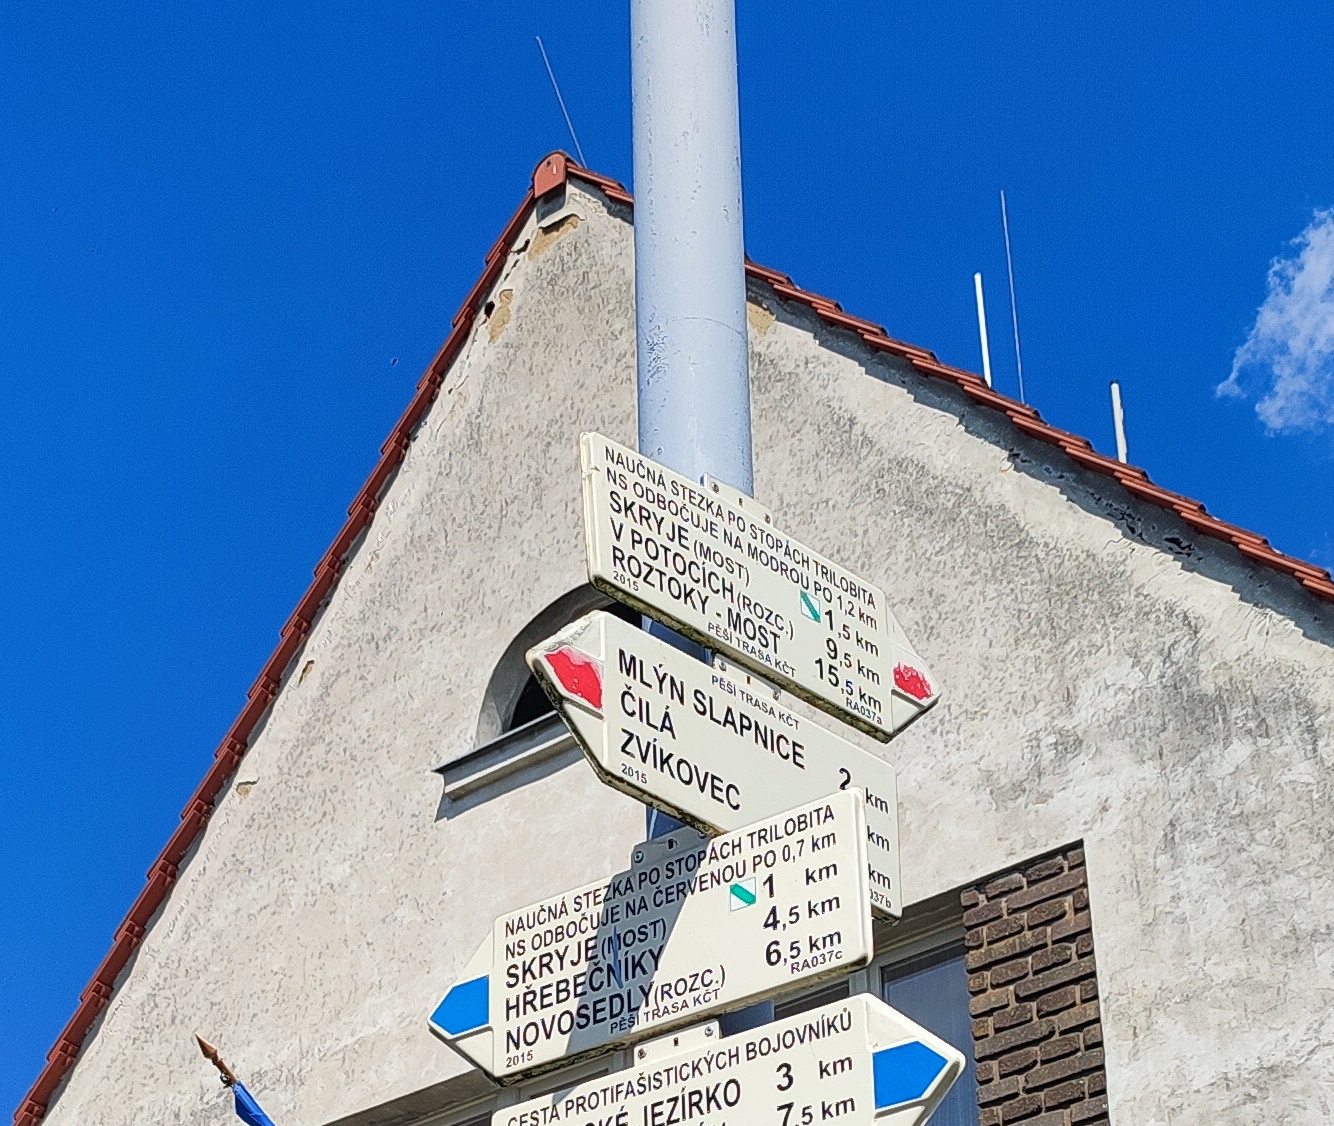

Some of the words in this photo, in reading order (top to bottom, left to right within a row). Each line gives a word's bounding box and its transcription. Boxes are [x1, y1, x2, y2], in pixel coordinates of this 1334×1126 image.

[605, 446, 667, 498] NAUČNÁ
[671, 480, 724, 522] STEZKA
[728, 510, 745, 532] PO
[750, 524, 809, 571] STOPÁCH
[813, 560, 876, 609] TRILOBITA
[607, 467, 627, 490] NS
[633, 482, 718, 539] ODBOČUJE
[724, 530, 743, 553] NA
[748, 542, 809, 595] MODROU
[814, 581, 832, 603] PO
[837, 595, 855, 617] 1,2
[859, 610, 877, 630] km
[610, 490, 690, 551] SKRYJE
[694, 540, 749, 586] (MOST)
[825, 611, 850, 640] 1,5
[856, 631, 878, 657] km
[611, 571, 639, 591] 2015
[610, 517, 623, 542] V
[631, 528, 734, 604] POTOCÍCH
[736, 592, 793, 640] (ROZC.)
[826, 638, 852, 668] 9,5
[857, 659, 880, 685] km
[612, 545, 709, 614] ROZTOKY
[727, 607, 780, 654] MOST
[815, 660, 853, 696] 15,5
[855, 686, 881, 713] km
[736, 637, 772, 667] TRASA
[619, 648, 684, 706] MLÝN
[693, 689, 805, 770] SLAPNICE
[866, 787, 888, 814] km
[739, 689, 776, 717] TRASA
[620, 763, 647, 784] 2015
[621, 685, 676, 740] ČILÁ
[867, 825, 890, 851] km
[621, 728, 740, 810] ZVÍKOVEC
[868, 863, 891, 889] km
[506, 896, 568, 938] NAUČNÁ
[574, 876, 635, 912] STEZKA
[639, 867, 661, 890] PO
[665, 837, 741, 879] STOPÁCH
[747, 805, 834, 848] TRILOBITA
[506, 940, 526, 960] NS
[531, 905, 621, 950] ODBOČUJE
[626, 896, 648, 919] NA
[653, 860, 746, 907] ČERVENOU
[753, 850, 776, 873] PO
[783, 839, 804, 863] 0,7
[812, 833, 836, 852] km
[506, 932, 599, 988] SKRYJE
[763, 873, 774, 898] 1
[805, 864, 837, 885] km
[506, 943, 667, 1022] HŘEBEČNÍKY
[763, 905, 799, 930] 4,5
[808, 897, 840, 918] km
[507, 982, 654, 1054] NOVOSEDLY
[766, 940, 801, 966] 6,5
[809, 931, 841, 953] km
[644, 1000, 689, 1022] TRASA
[791, 951, 842, 974] RA037c
[506, 1050, 533, 1068] 2015
[564, 1046, 739, 1118] PROTIFAŠISTICKÝCH
[746, 1008, 851, 1061] BOJOVNÍKŮ
[776, 1063, 793, 1091] 3
[819, 1057, 852, 1079] km
[821, 1098, 855, 1120] km
